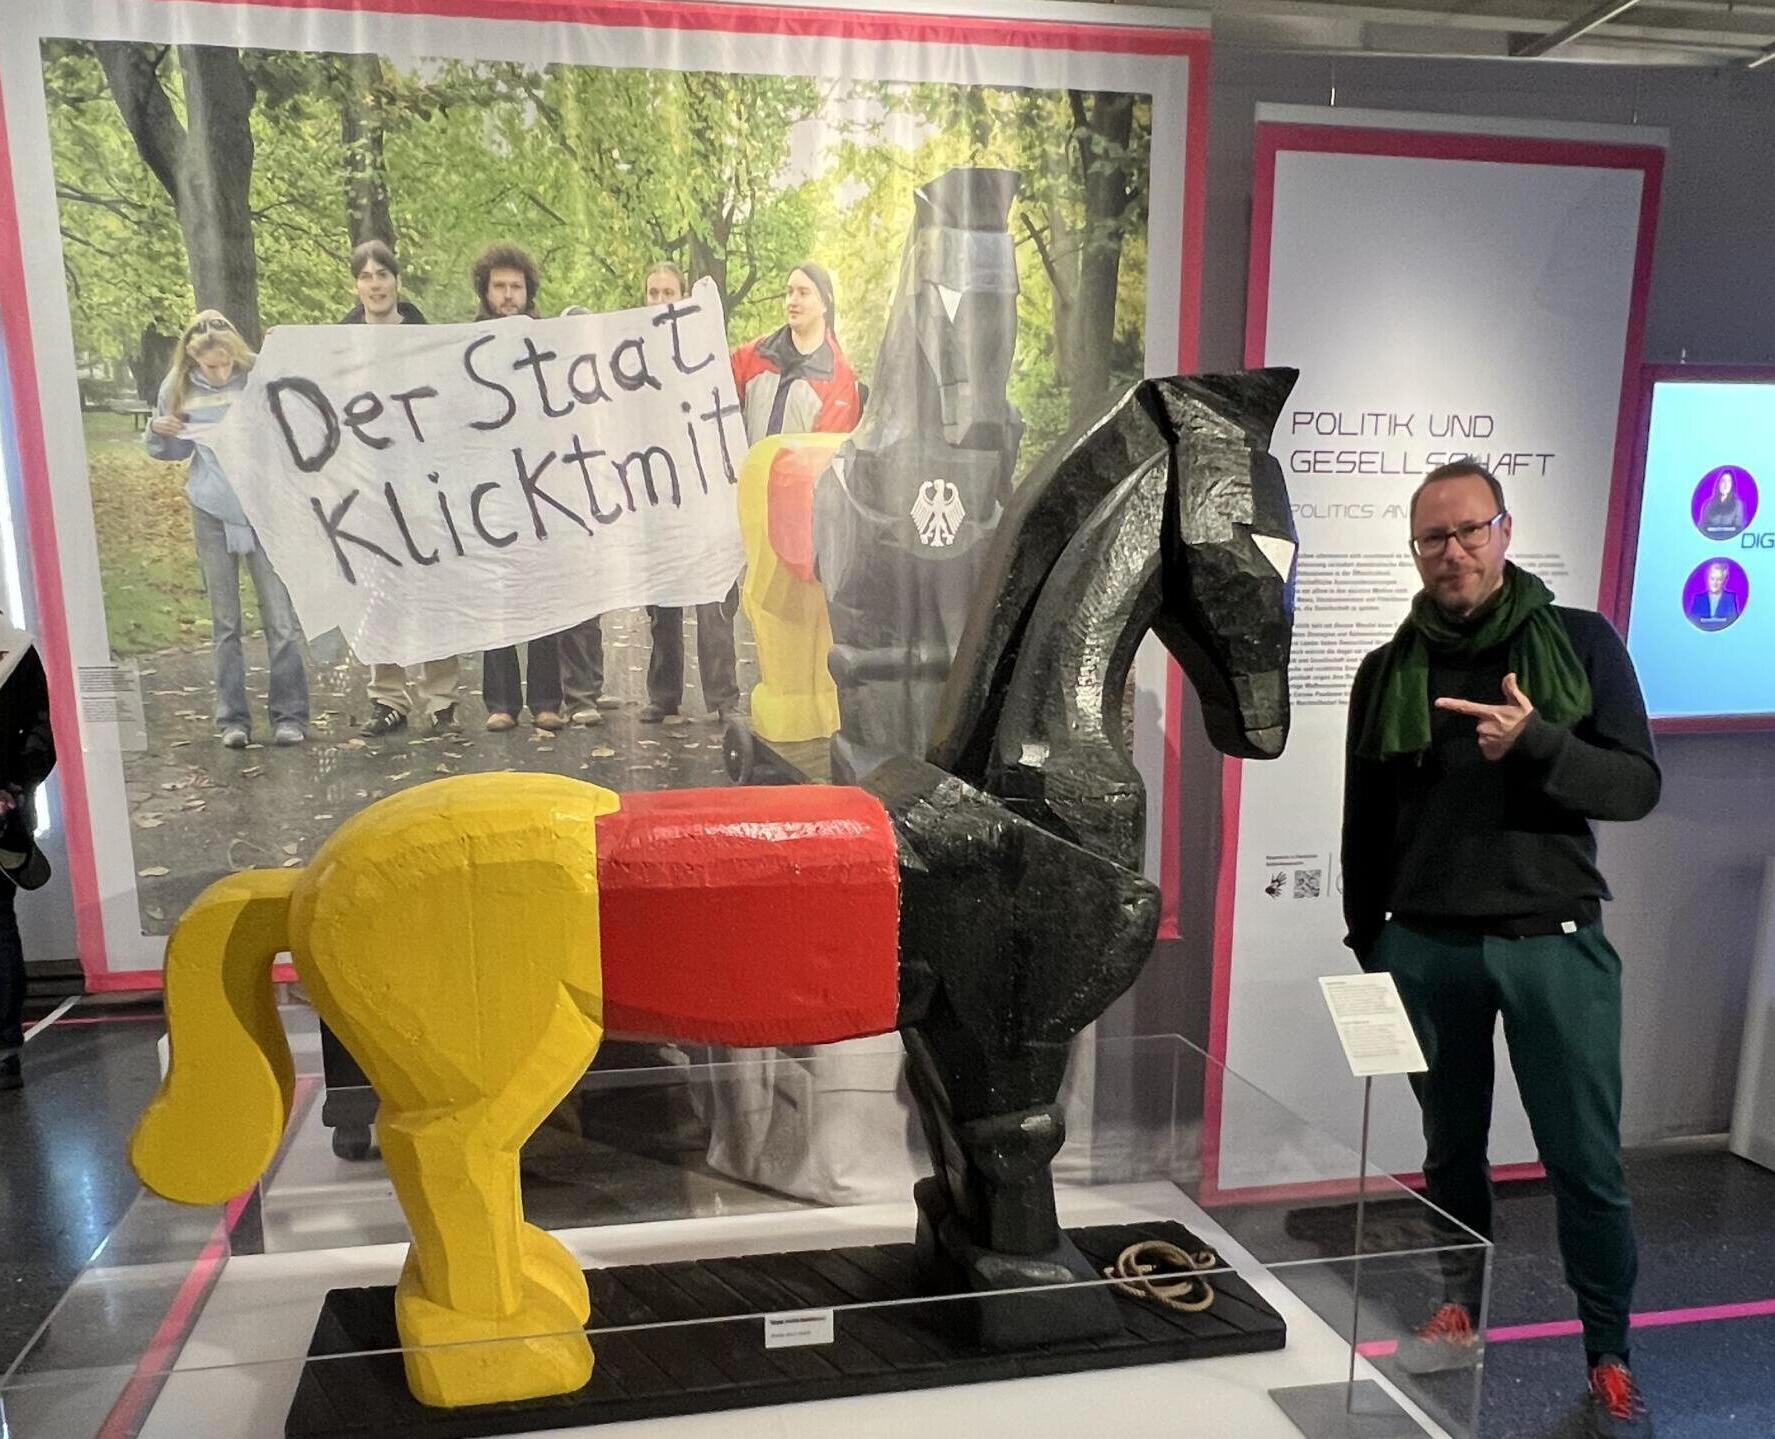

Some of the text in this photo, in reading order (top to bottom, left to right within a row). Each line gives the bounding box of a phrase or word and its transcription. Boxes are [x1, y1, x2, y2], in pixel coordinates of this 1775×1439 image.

[266, 303, 715, 473] Der Staat
[1292, 411, 1494, 438] POLITIK UND
[1741, 532, 1775, 549] DIG
